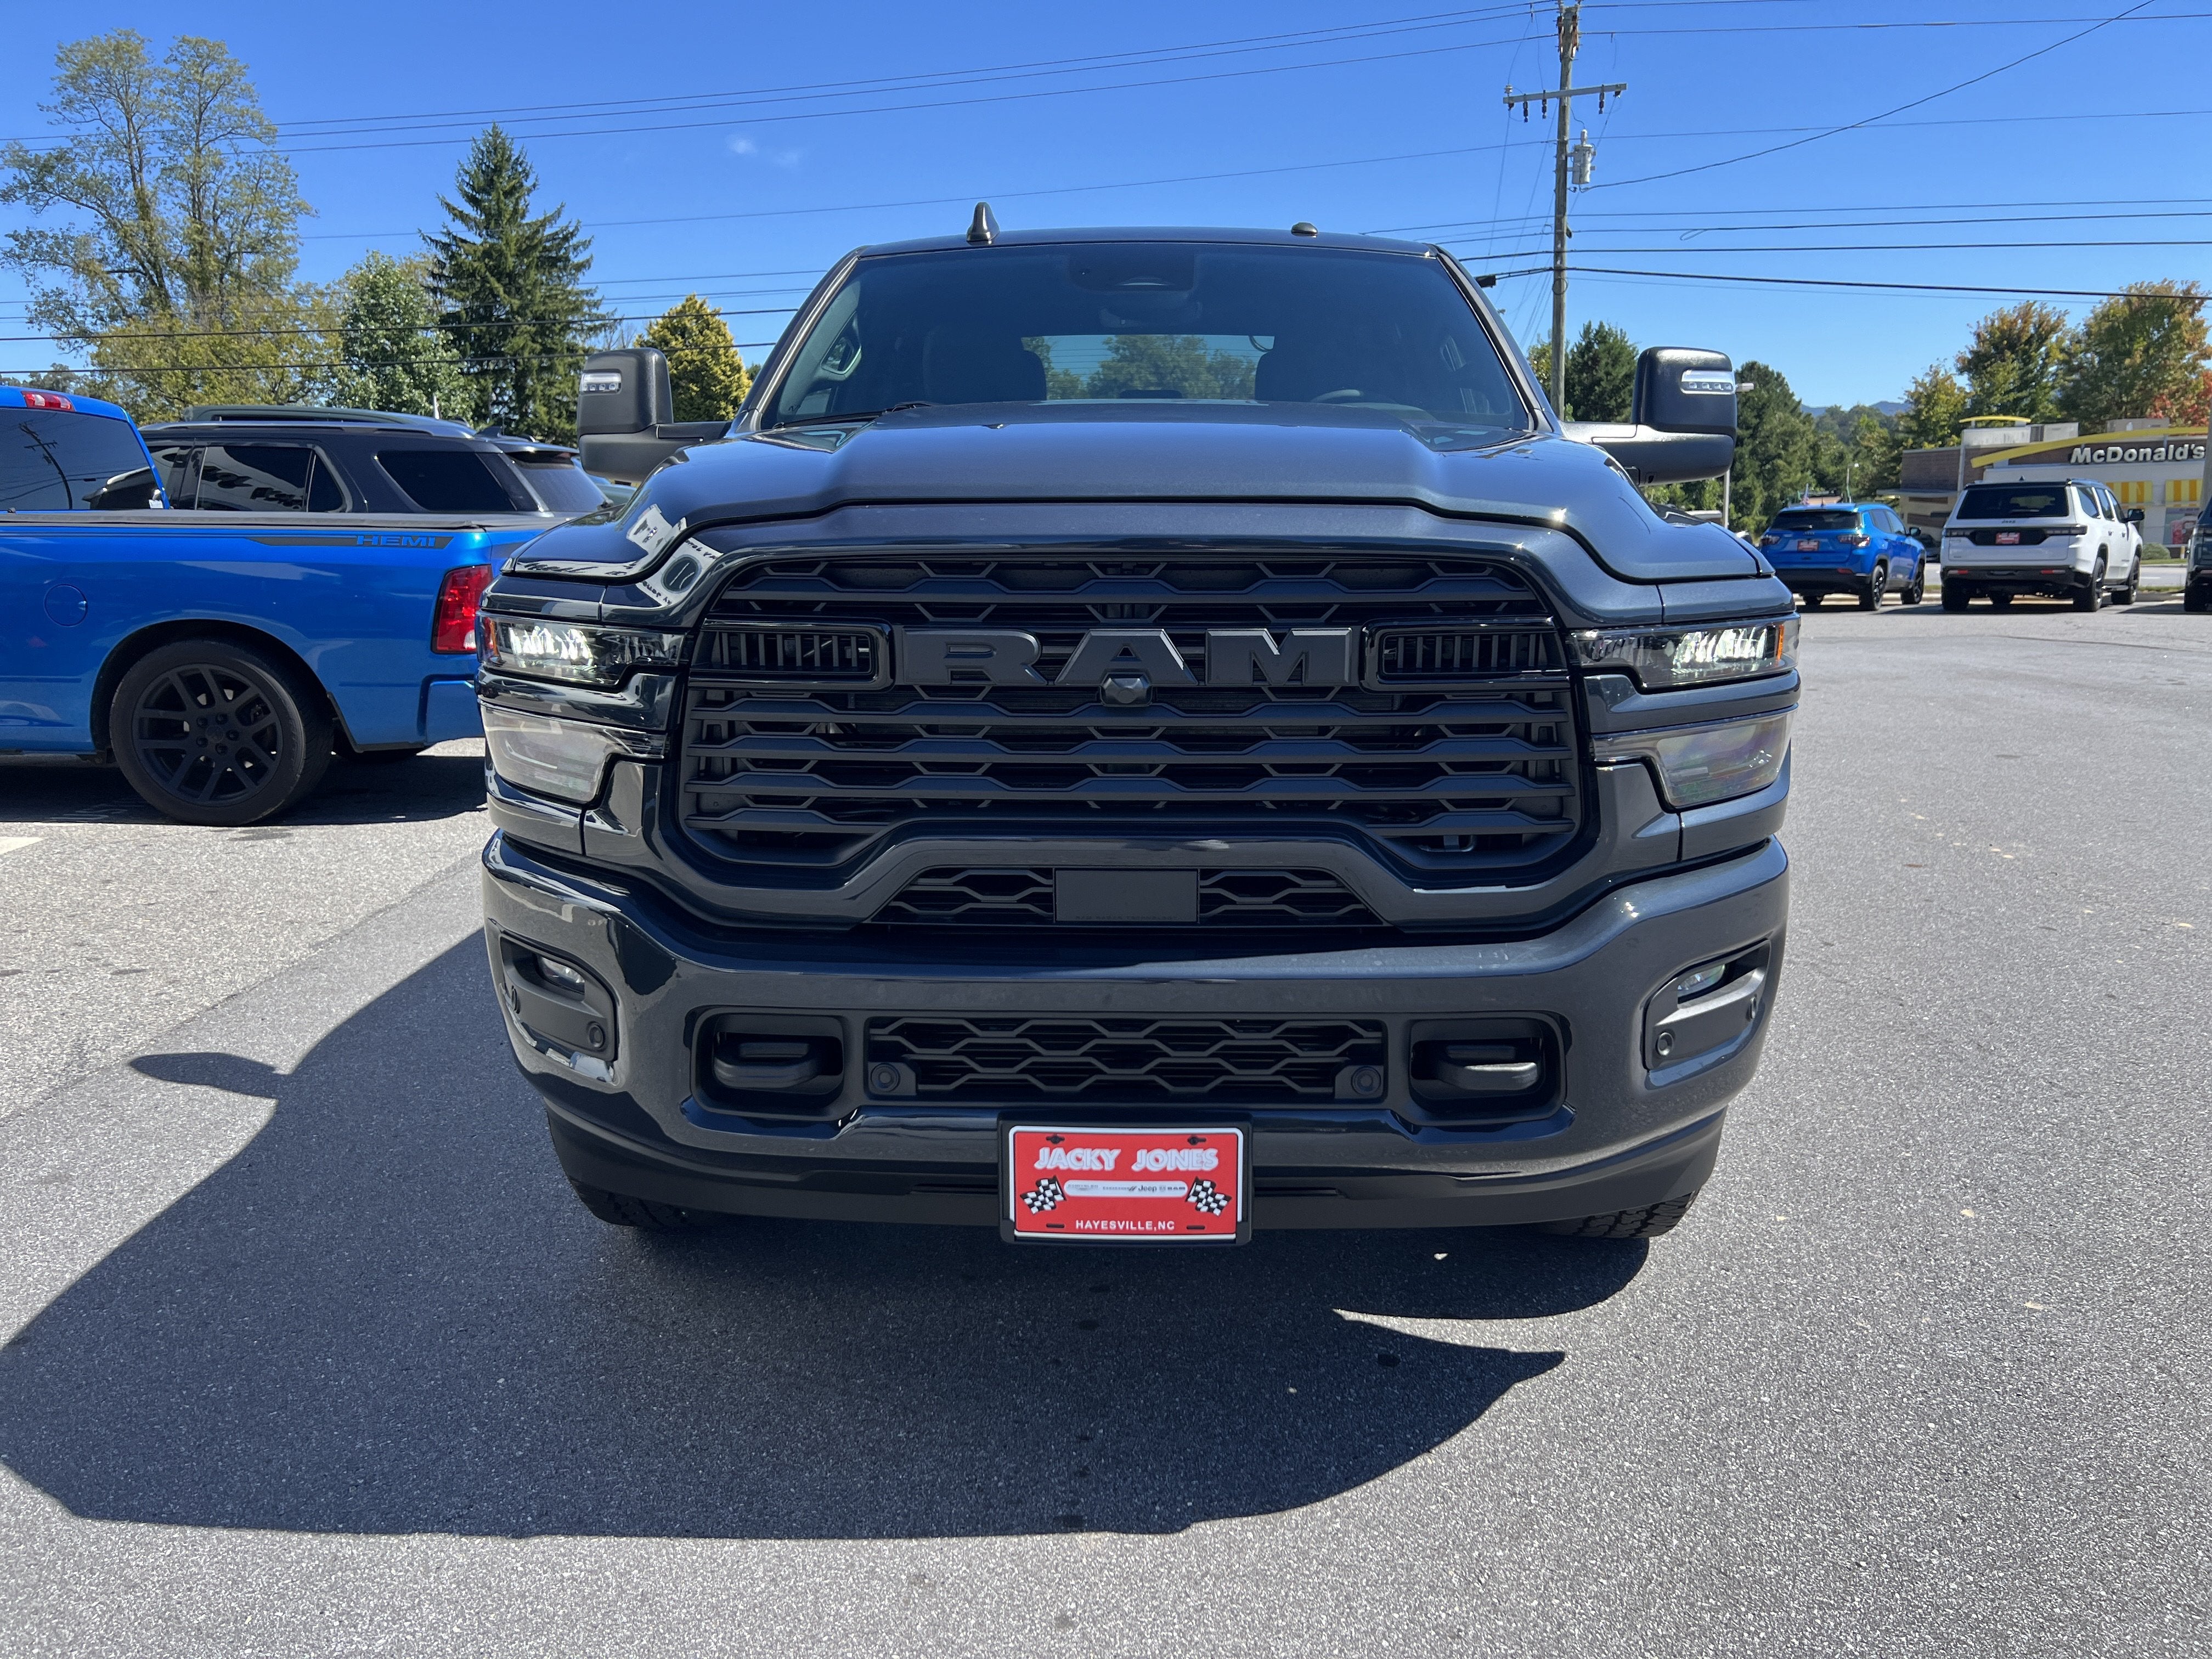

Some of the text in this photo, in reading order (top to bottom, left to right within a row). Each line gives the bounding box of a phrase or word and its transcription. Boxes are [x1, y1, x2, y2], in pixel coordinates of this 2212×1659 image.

[2070, 444, 2205, 464] McDonald's
[357, 535, 436, 548] HEMI
[903, 627, 1353, 686] RAM
[1034, 1147, 1219, 1172] JACKY JONES
